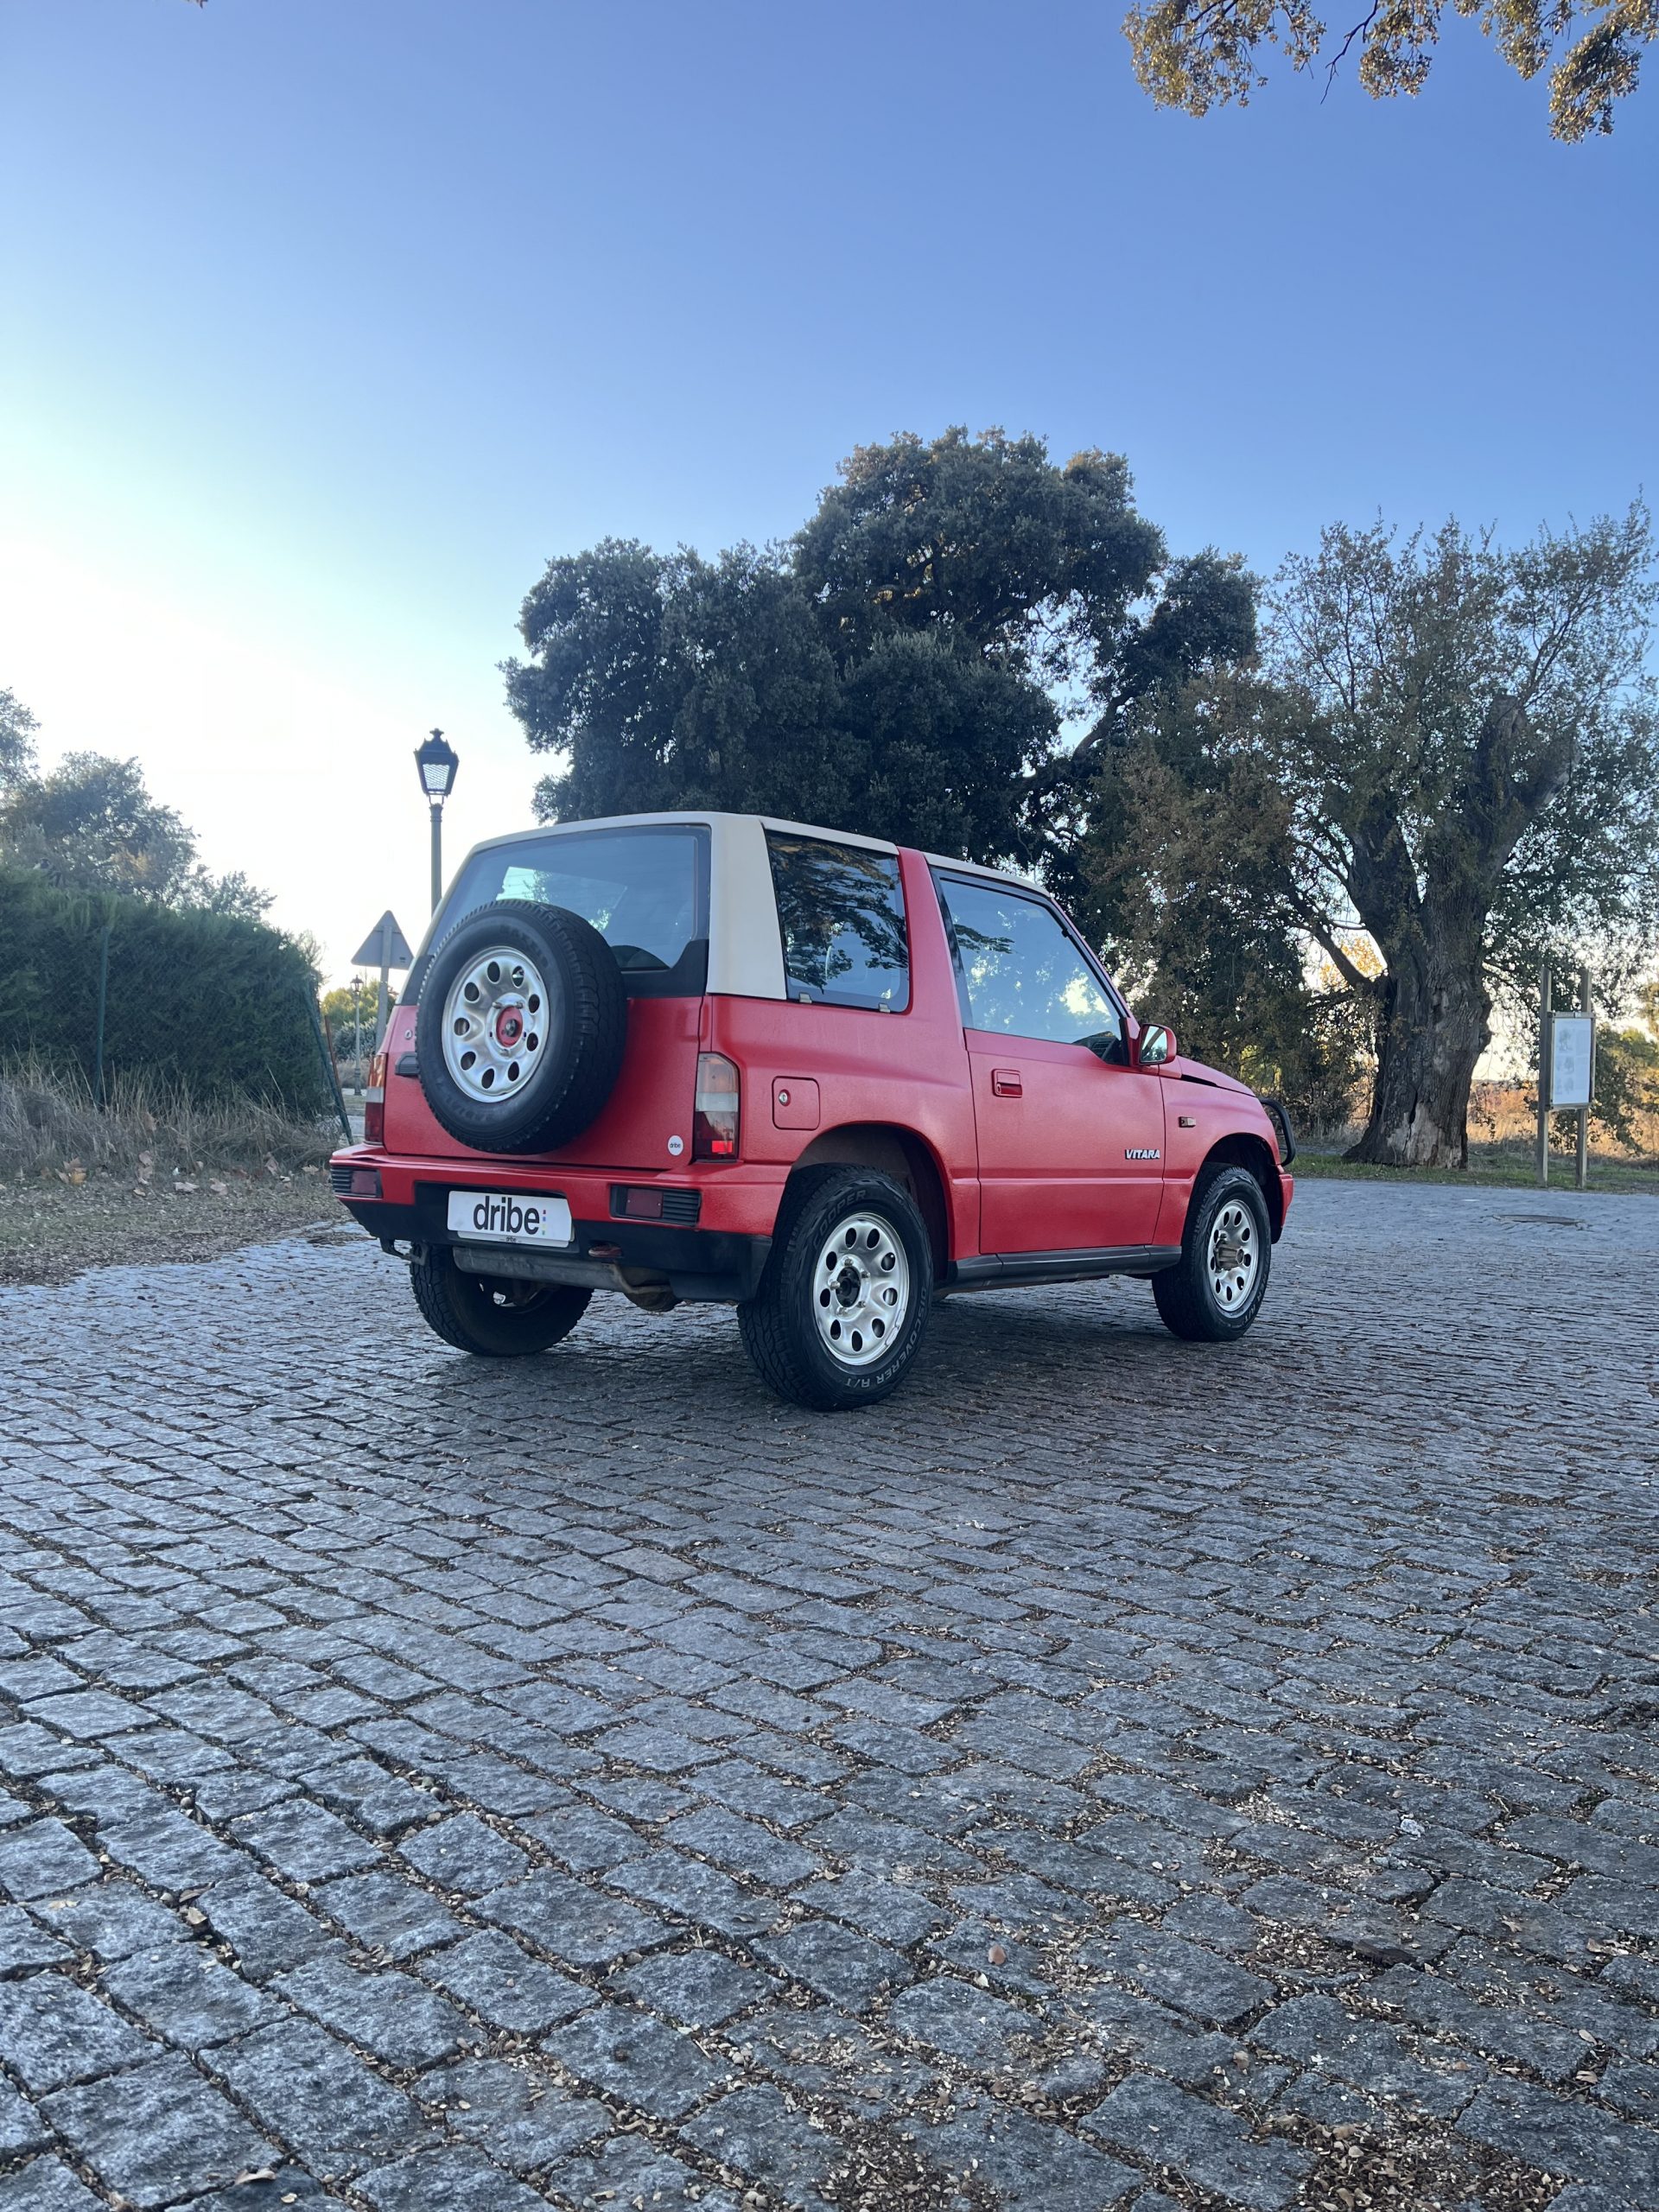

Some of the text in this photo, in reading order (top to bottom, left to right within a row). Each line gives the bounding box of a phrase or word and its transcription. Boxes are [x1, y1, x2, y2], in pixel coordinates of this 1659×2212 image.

[1124, 1148, 1160, 1160] VITARA
[474, 1196, 540, 1235] dribe
[813, 1189, 867, 1249] COOPER
[845, 1287, 927, 1389] DISCOVERER A/T
